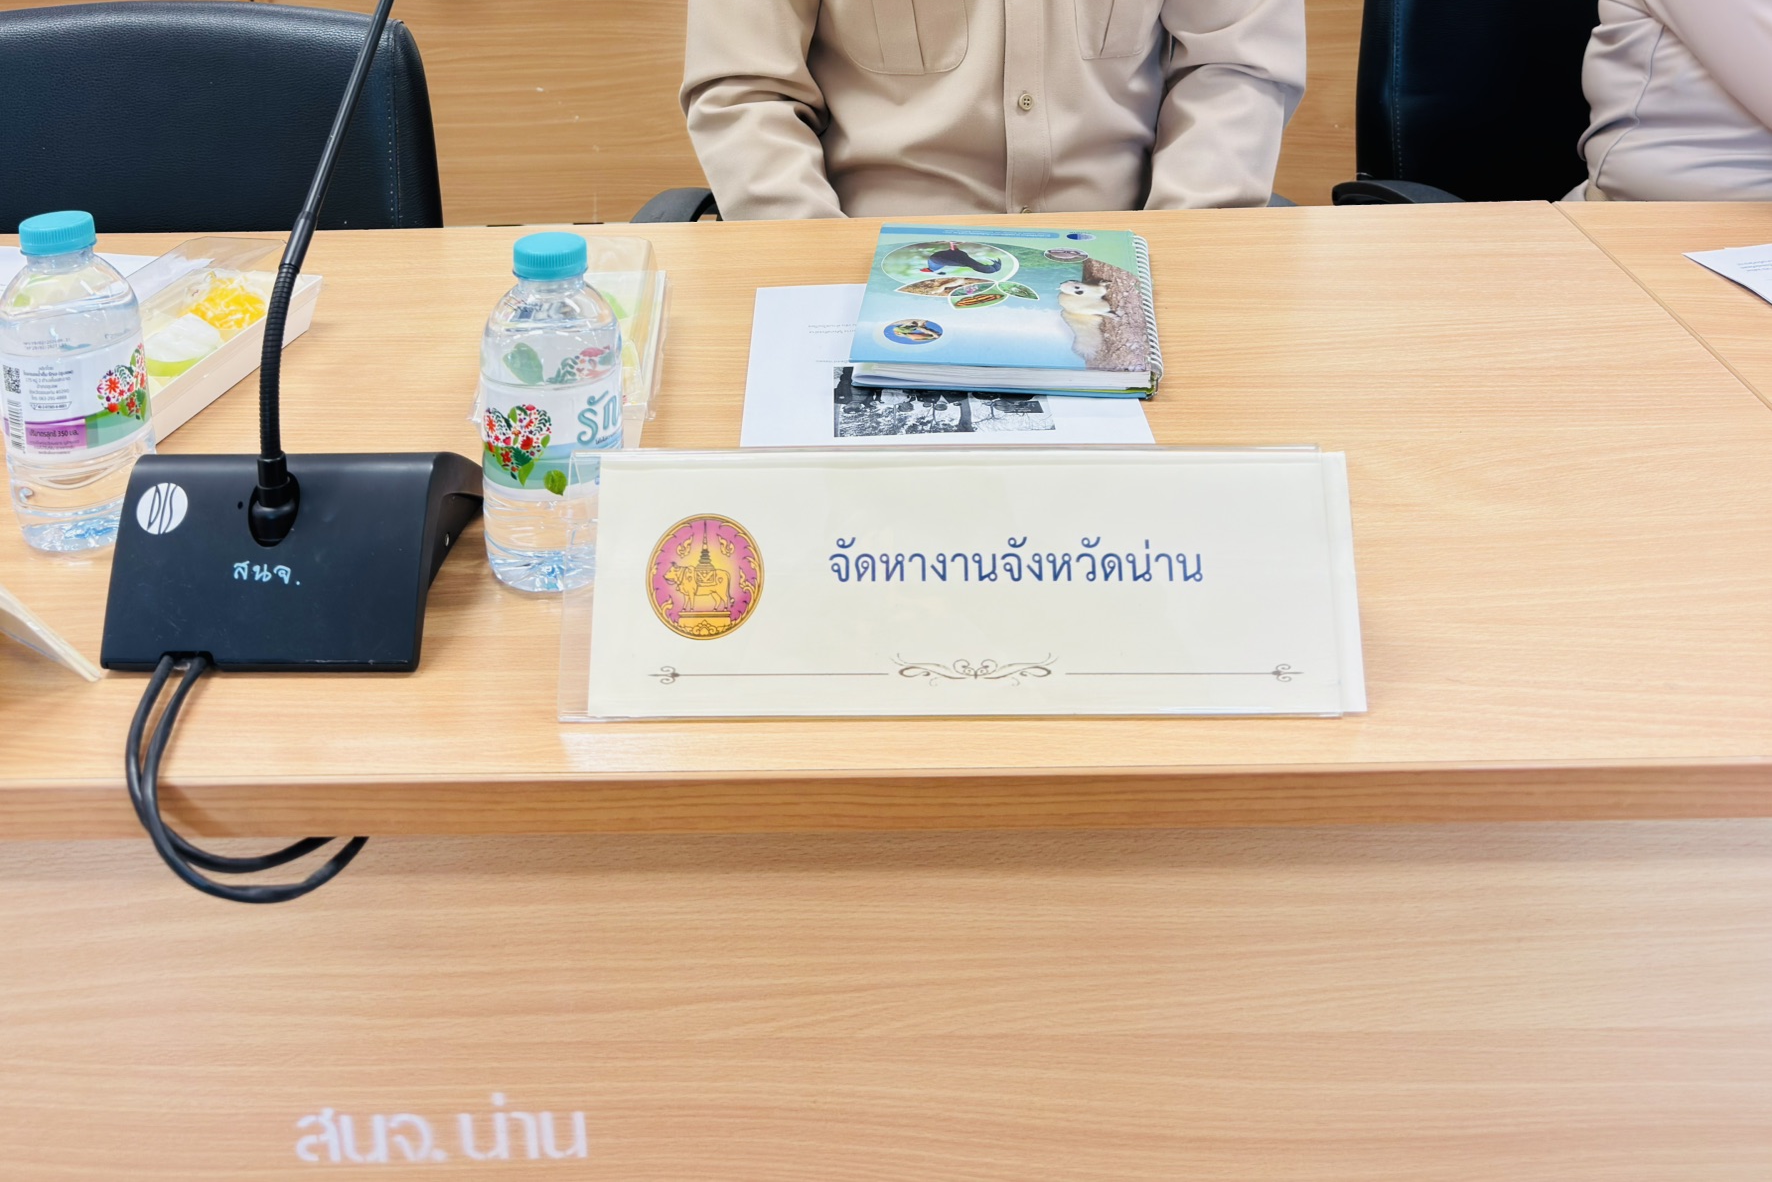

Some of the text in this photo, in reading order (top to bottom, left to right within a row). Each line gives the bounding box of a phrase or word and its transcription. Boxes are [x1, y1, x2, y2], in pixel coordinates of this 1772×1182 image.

[577, 390, 620, 445] รัก
[233, 560, 301, 586] สนจ.
[828, 536, 1203, 583] จัดหางานจังหวัดน่าน
[457, 1092, 588, 1160] น่าน
